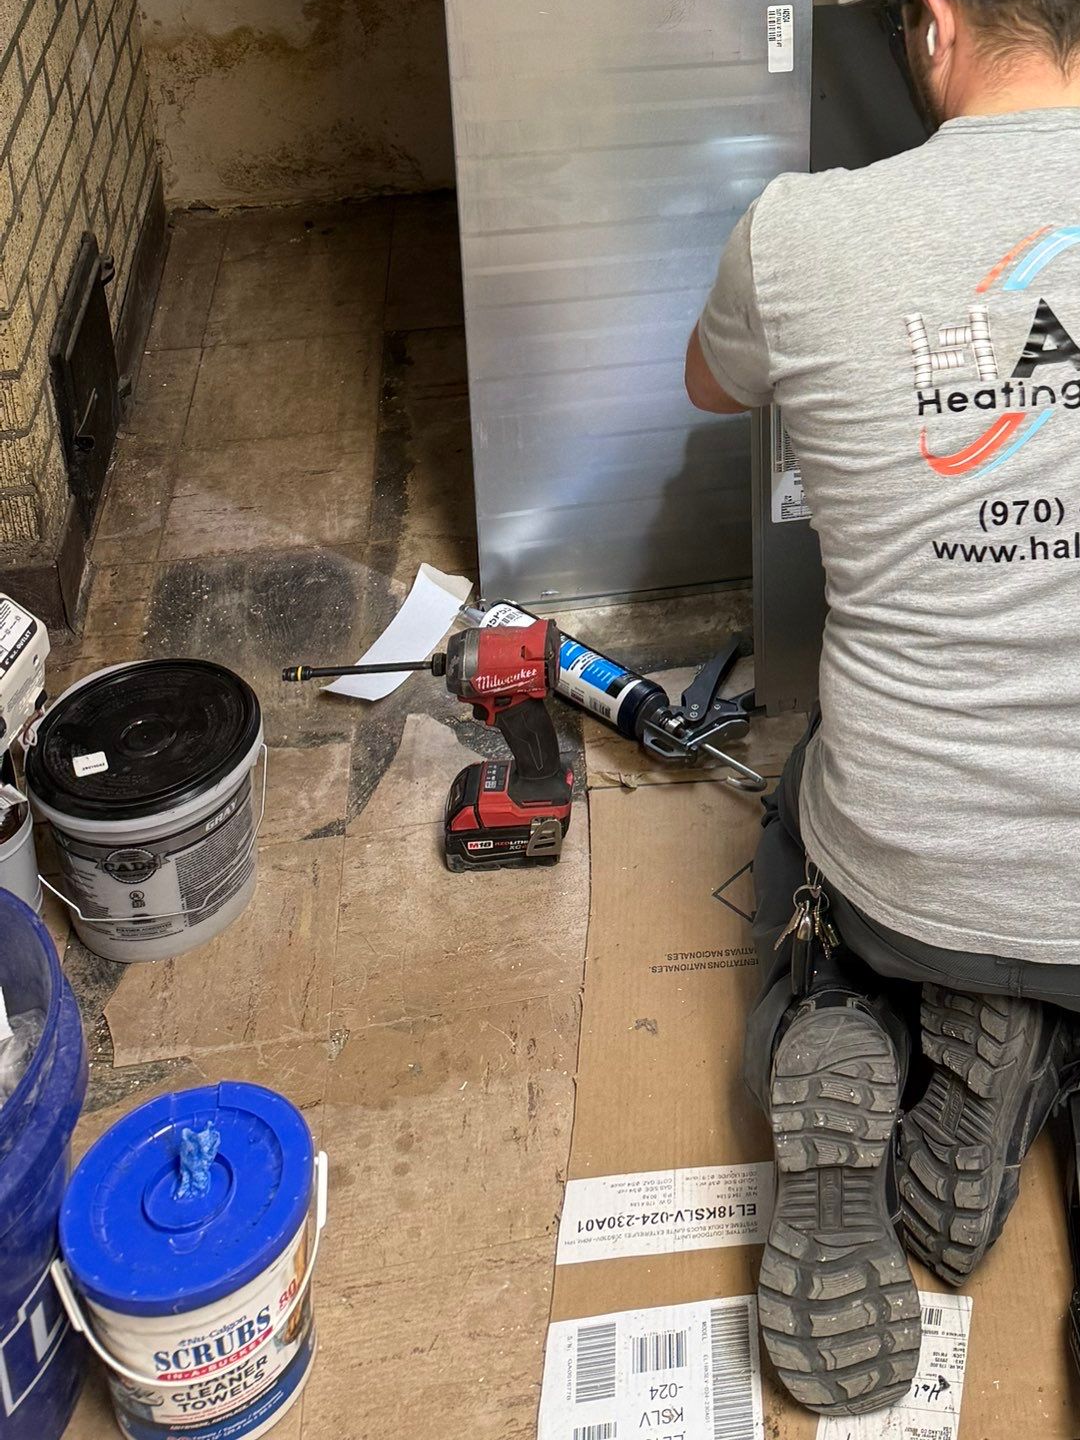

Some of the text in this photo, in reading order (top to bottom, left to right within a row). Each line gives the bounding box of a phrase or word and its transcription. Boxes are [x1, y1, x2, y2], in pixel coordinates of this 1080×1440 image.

[978, 497, 1066, 532] (970)
[16, 630, 32, 650] OUTLET
[476, 668, 537, 689] Milwaukee
[205, 799, 238, 832] GRAY
[468, 841, 492, 849] M18
[665, 950, 723, 960] NACIONALES.
[649, 962, 706, 973] NATIONALES.
[577, 1203, 757, 1233] EL18KSLV-024-230A01
[153, 1305, 272, 1372] SCRUBS
[171, 1355, 268, 1402] CLEANER
[177, 1370, 265, 1412] TOWELS
[650, 1383, 683, 1400] -024
[639, 1407, 684, 1428] KSLV
